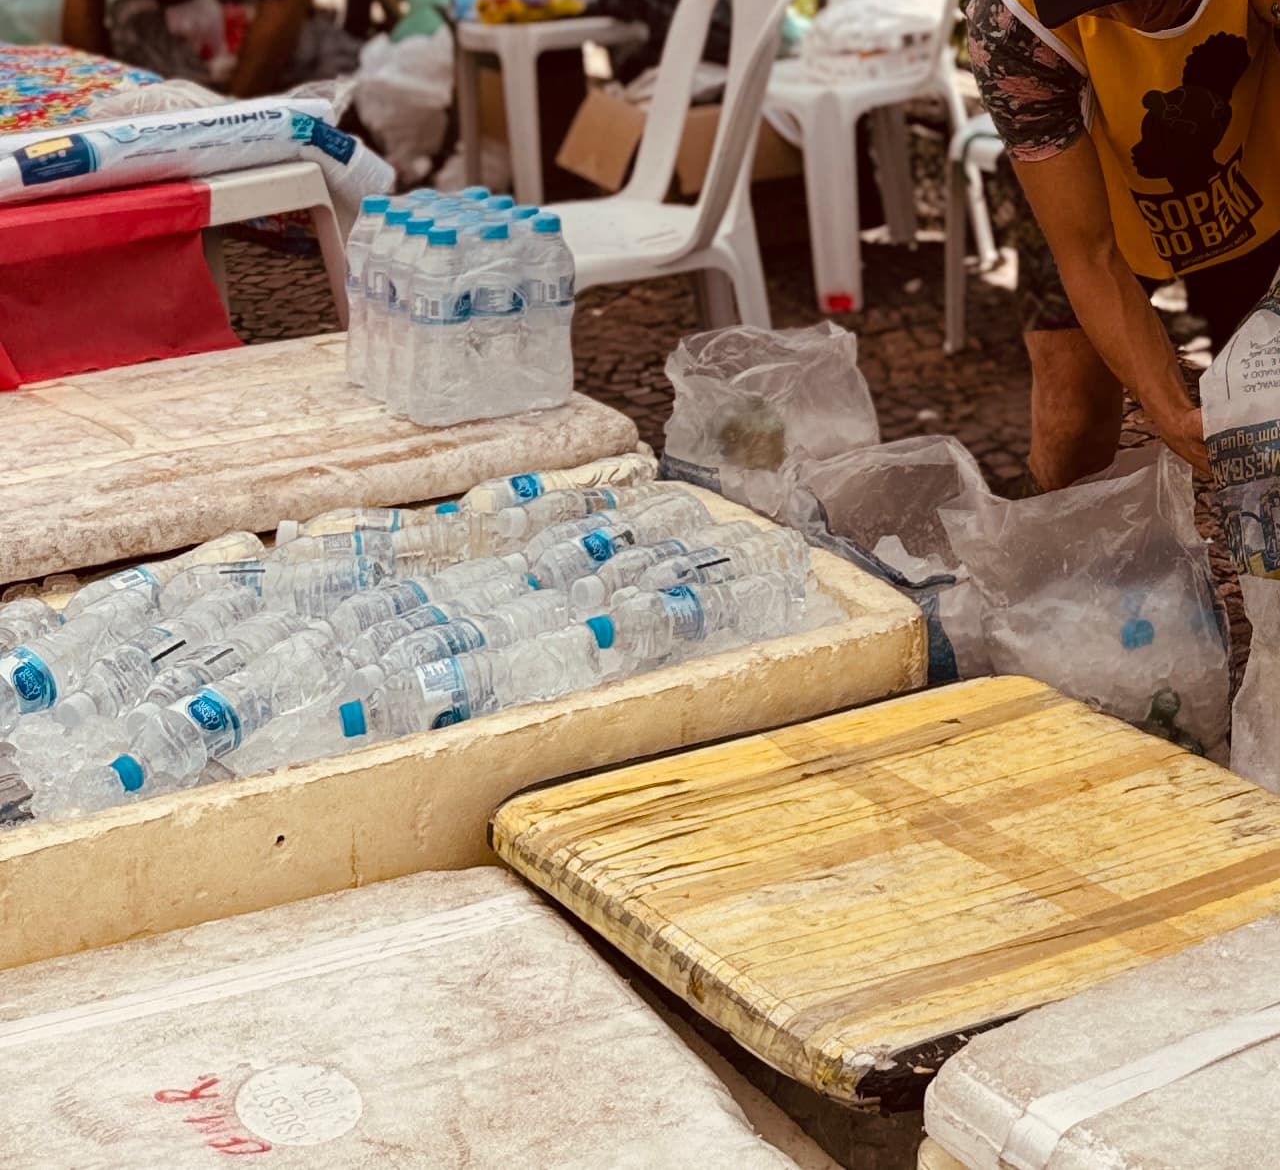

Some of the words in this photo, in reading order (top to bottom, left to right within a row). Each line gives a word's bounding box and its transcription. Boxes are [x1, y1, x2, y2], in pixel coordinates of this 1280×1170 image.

[1151, 230, 1193, 258] DO
[1200, 182, 1255, 248] BEM
[1220, 429, 1255, 451] água
